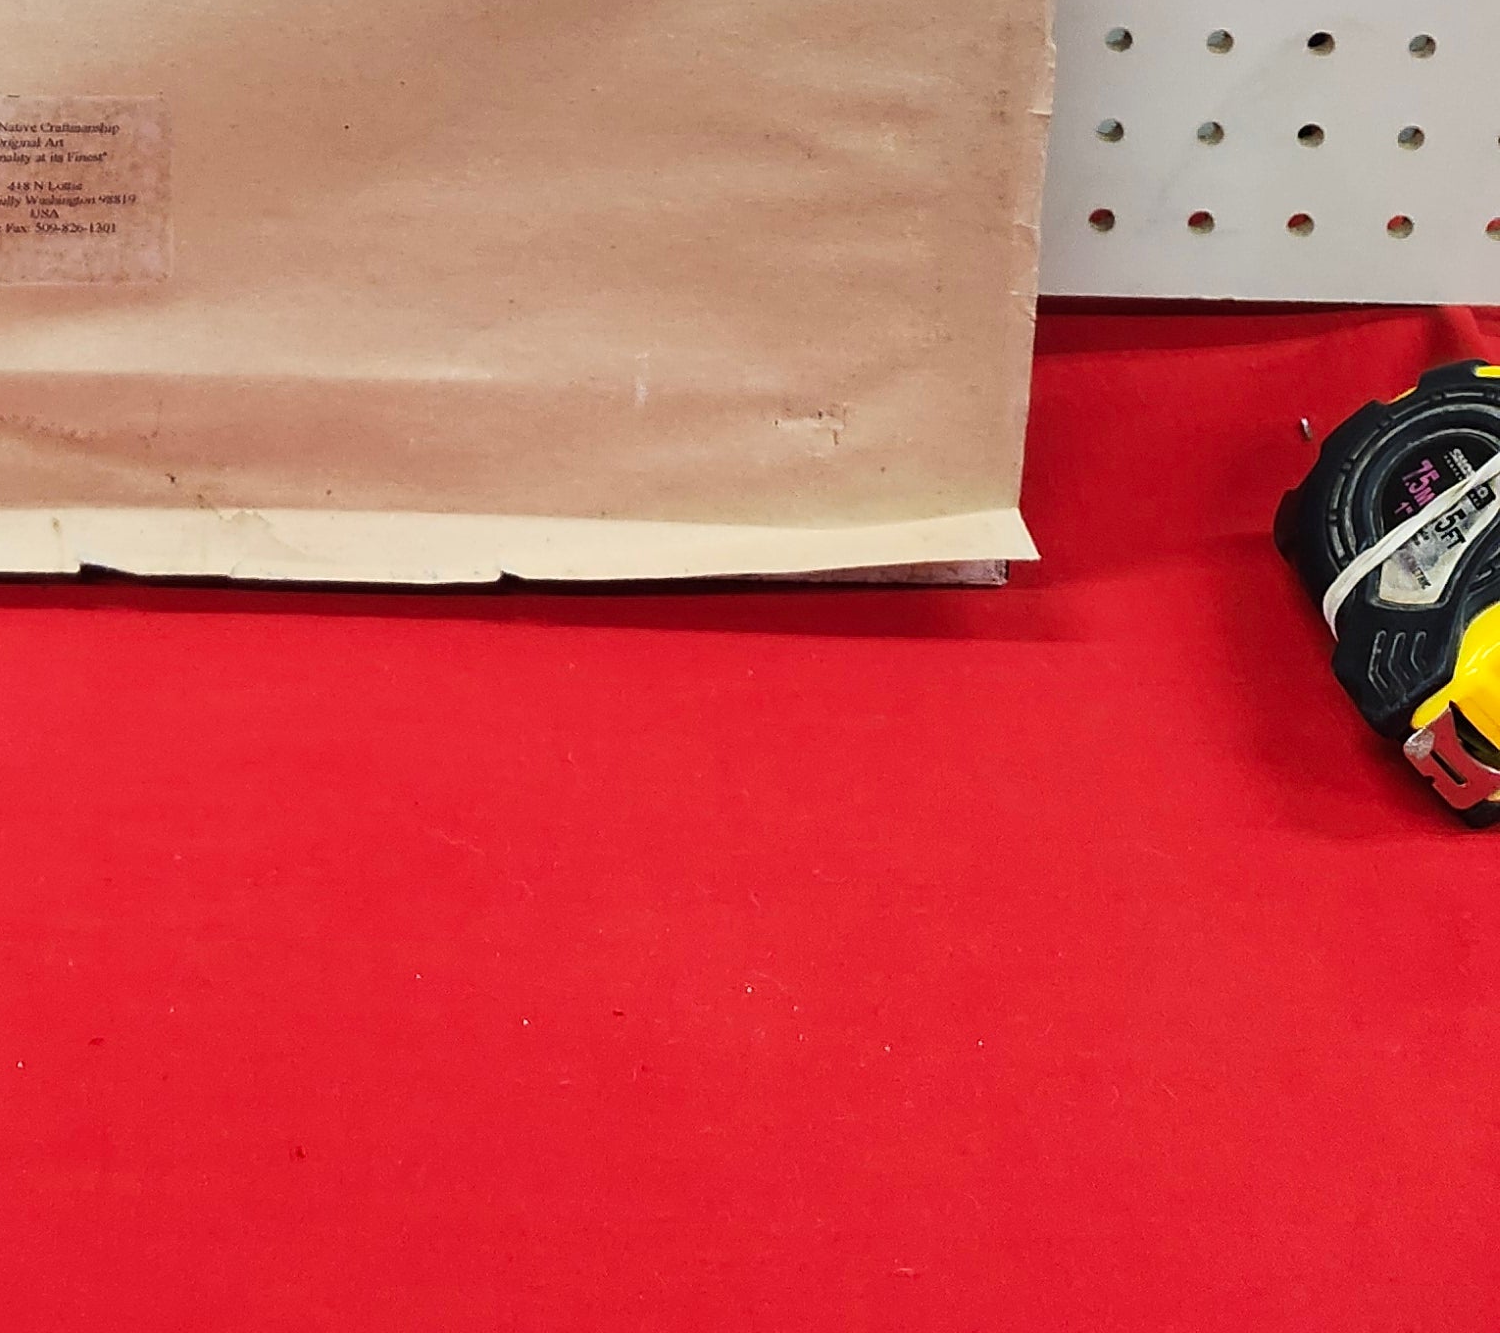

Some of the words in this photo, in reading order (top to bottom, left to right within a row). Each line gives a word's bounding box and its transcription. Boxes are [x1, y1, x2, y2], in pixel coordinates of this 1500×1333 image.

[45, 138, 64, 148] Art
[35, 153, 46, 163] at
[50, 153, 64, 164] its
[6, 181, 30, 192] 418
[34, 181, 44, 191] N
[25, 195, 96, 208] Washington
[30, 209, 60, 219] USA
